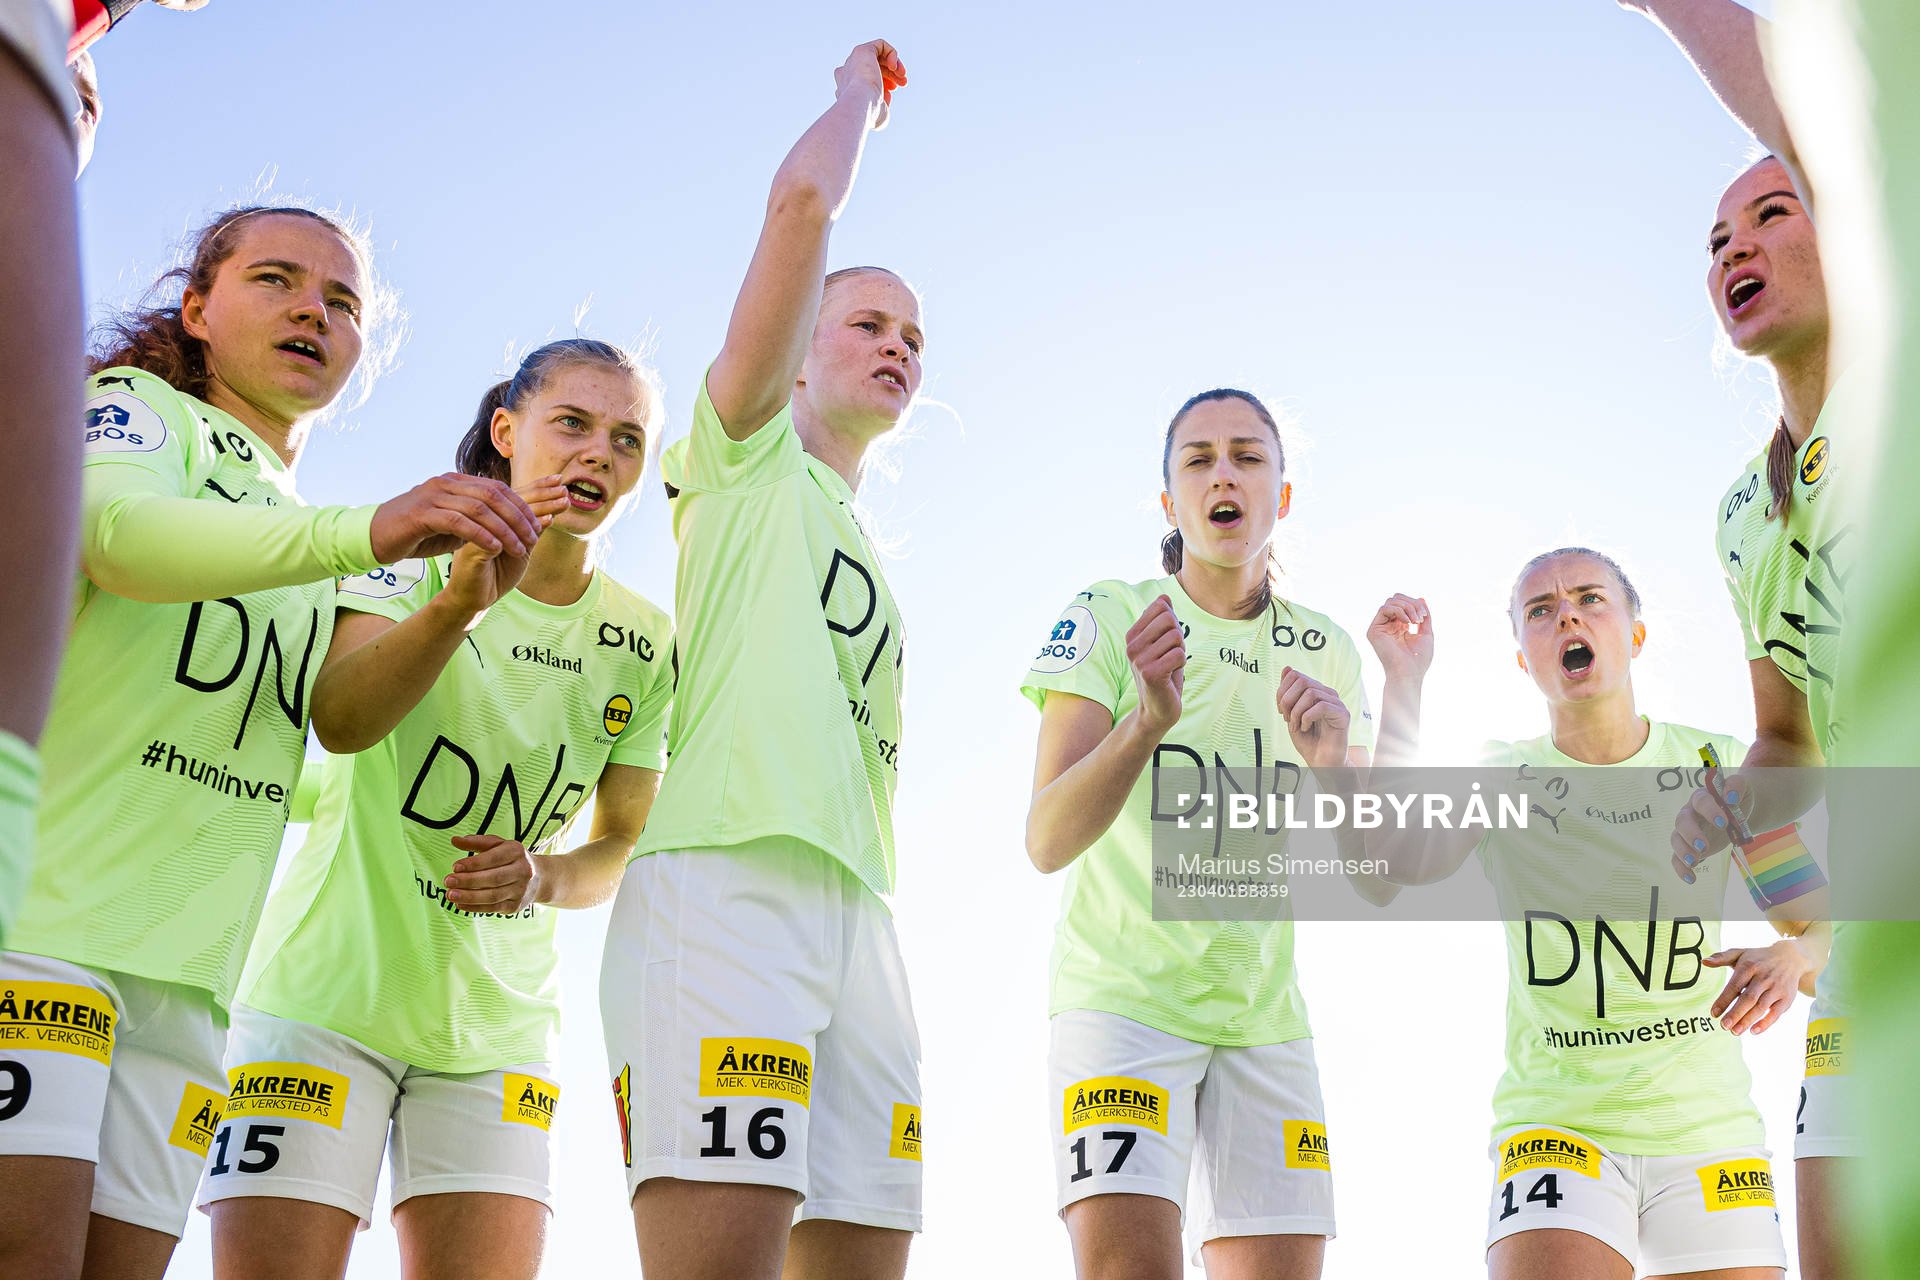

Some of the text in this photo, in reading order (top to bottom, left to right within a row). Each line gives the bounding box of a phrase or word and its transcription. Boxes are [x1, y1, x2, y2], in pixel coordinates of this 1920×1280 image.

[86, 425, 144, 445] BOS
[511, 644, 582, 675] Økland
[606, 709, 629, 722] LSK
[141, 740, 290, 803] #huninve
[1151, 727, 1301, 858] DNB
[1524, 886, 1705, 1019] DNB
[0, 990, 111, 1036] ÅKRENE
[36, 1028, 99, 1051] VERKSTED
[1544, 1016, 1715, 1049] #huninvesterer
[717, 1046, 808, 1083] ÅKRENE
[230, 1072, 334, 1102] ÅKRENE
[716, 1077, 748, 1088] MEK.
[751, 1078, 802, 1095] VERKSTED
[1072, 1088, 1159, 1112] ÅKRENE
[226, 1099, 330, 1118] MEK. VERKSTED AS
[1071, 1108, 1160, 1125] MEK. VERKSTED AS
[700, 1106, 787, 1160] 16
[210, 1125, 286, 1177] 15
[1070, 1131, 1137, 1183] 17
[1505, 1139, 1588, 1163] ÅKRENE
[1523, 1155, 1573, 1165] VERKSTED
[1575, 1161, 1588, 1170] AS
[1499, 1174, 1563, 1222] 14
[1718, 1193, 1744, 1203] MEK.
